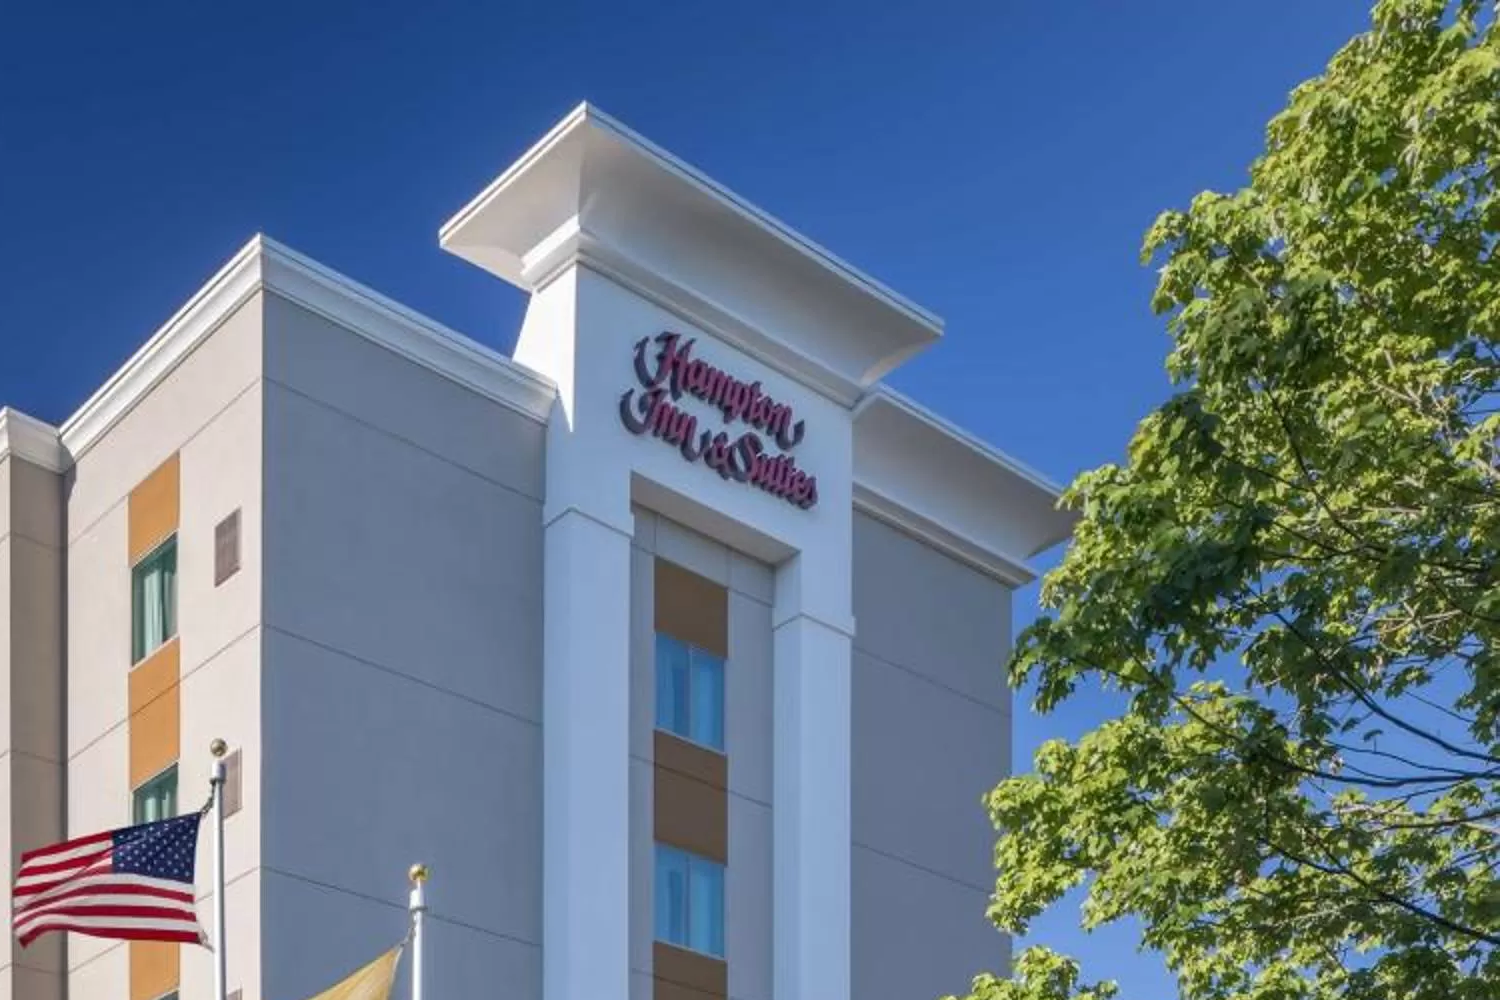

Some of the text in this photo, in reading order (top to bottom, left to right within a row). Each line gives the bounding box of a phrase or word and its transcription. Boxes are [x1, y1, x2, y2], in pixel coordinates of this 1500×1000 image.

[619, 387, 712, 463] Inn
[729, 432, 819, 510] Suites
[633, 331, 805, 451] Hampton
